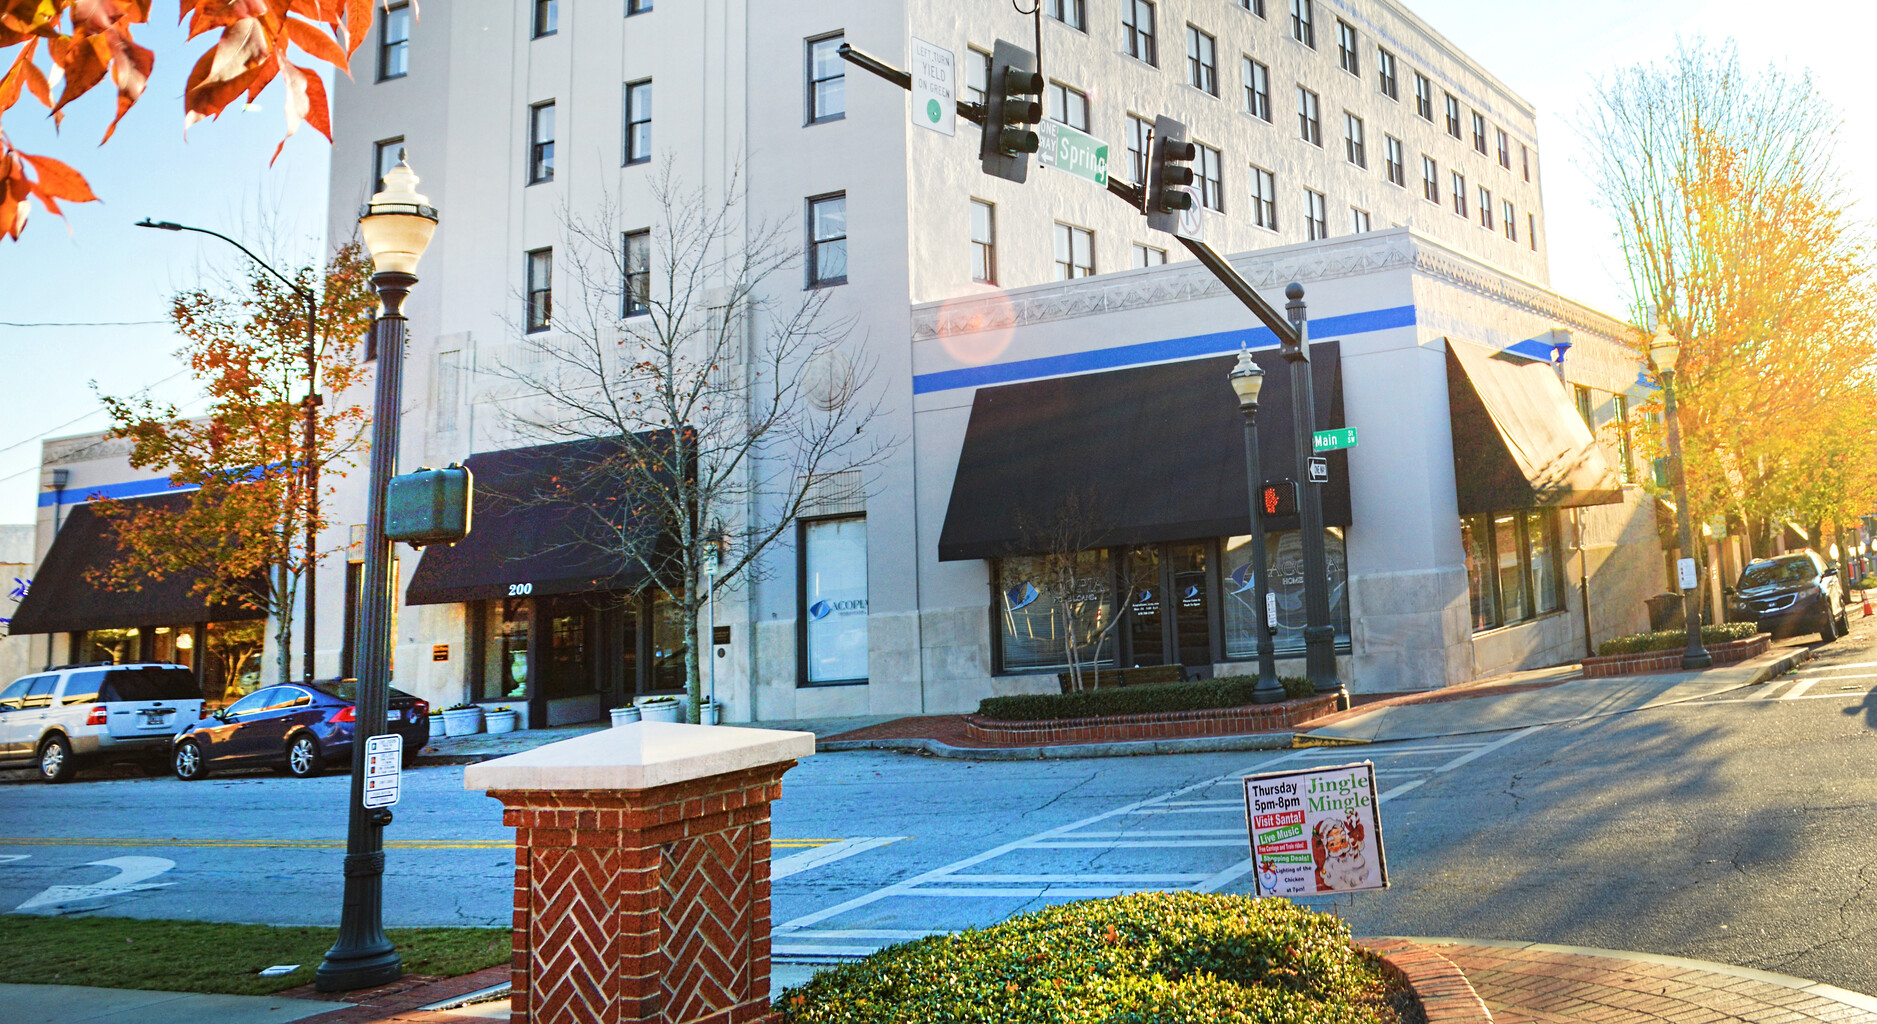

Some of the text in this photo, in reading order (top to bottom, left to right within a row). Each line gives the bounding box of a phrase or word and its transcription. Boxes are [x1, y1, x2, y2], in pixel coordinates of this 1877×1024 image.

[916, 43, 949, 66] LEFT TURN
[922, 61, 946, 81] YIELD
[918, 78, 949, 98] ON GREEN
[1040, 121, 1057, 137] ONE
[1039, 136, 1057, 152] WAY
[1060, 137, 1106, 182] Spring
[1314, 434, 1338, 447] Main
[508, 583, 532, 596] 200
[1252, 782, 1297, 797] Thursday
[1307, 773, 1369, 796] Jingle
[1255, 797, 1300, 813] 5pm-8pm
[1307, 792, 1370, 815] Mingle
[1255, 811, 1302, 828] Visit Santa!
[1260, 826, 1300, 845] Live Music
